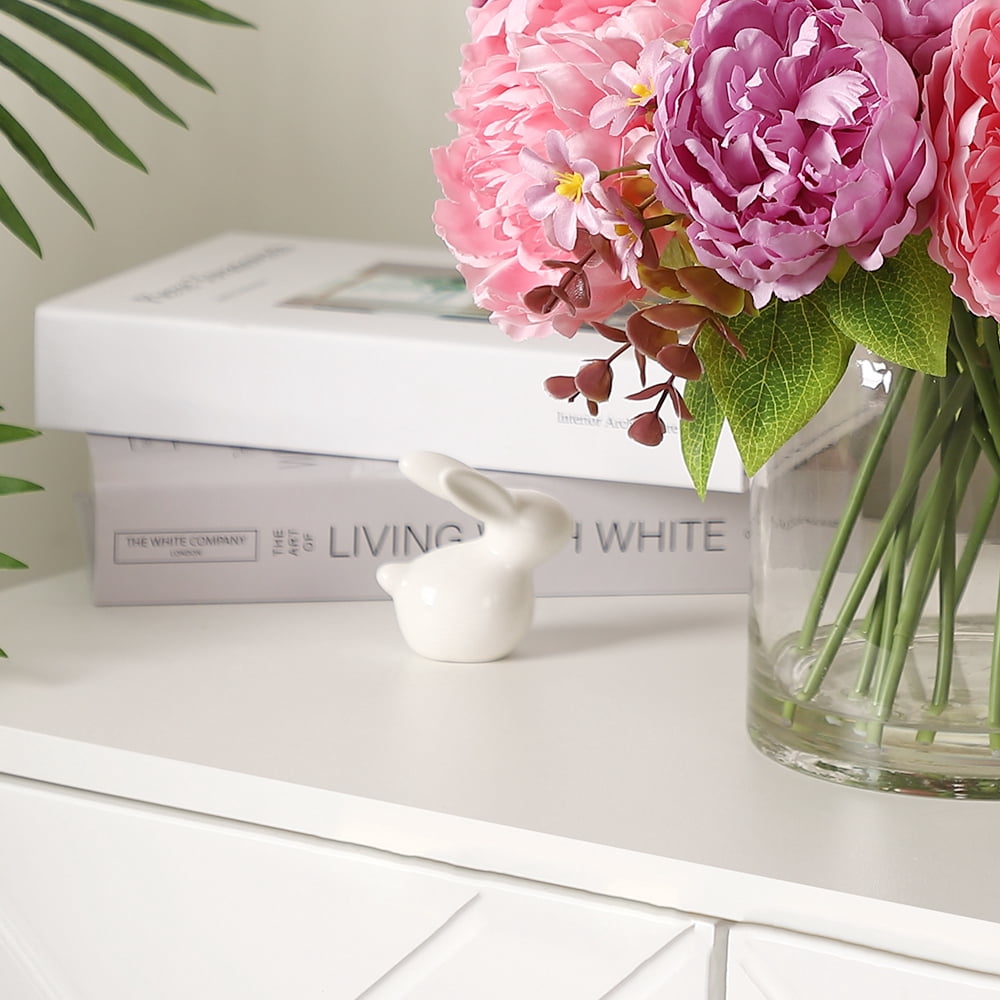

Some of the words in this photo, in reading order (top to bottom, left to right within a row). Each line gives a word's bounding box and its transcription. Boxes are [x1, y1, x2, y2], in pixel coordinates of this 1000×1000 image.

[127, 536, 148, 548] THE
[150, 536, 187, 548] WHITE
[189, 535, 246, 547] COMPANY
[272, 529, 284, 556] THE
[287, 529, 300, 556] ART
[302, 533, 314, 552] OF
[329, 522, 463, 558] LIVING
[595, 518, 727, 553] WHITE
